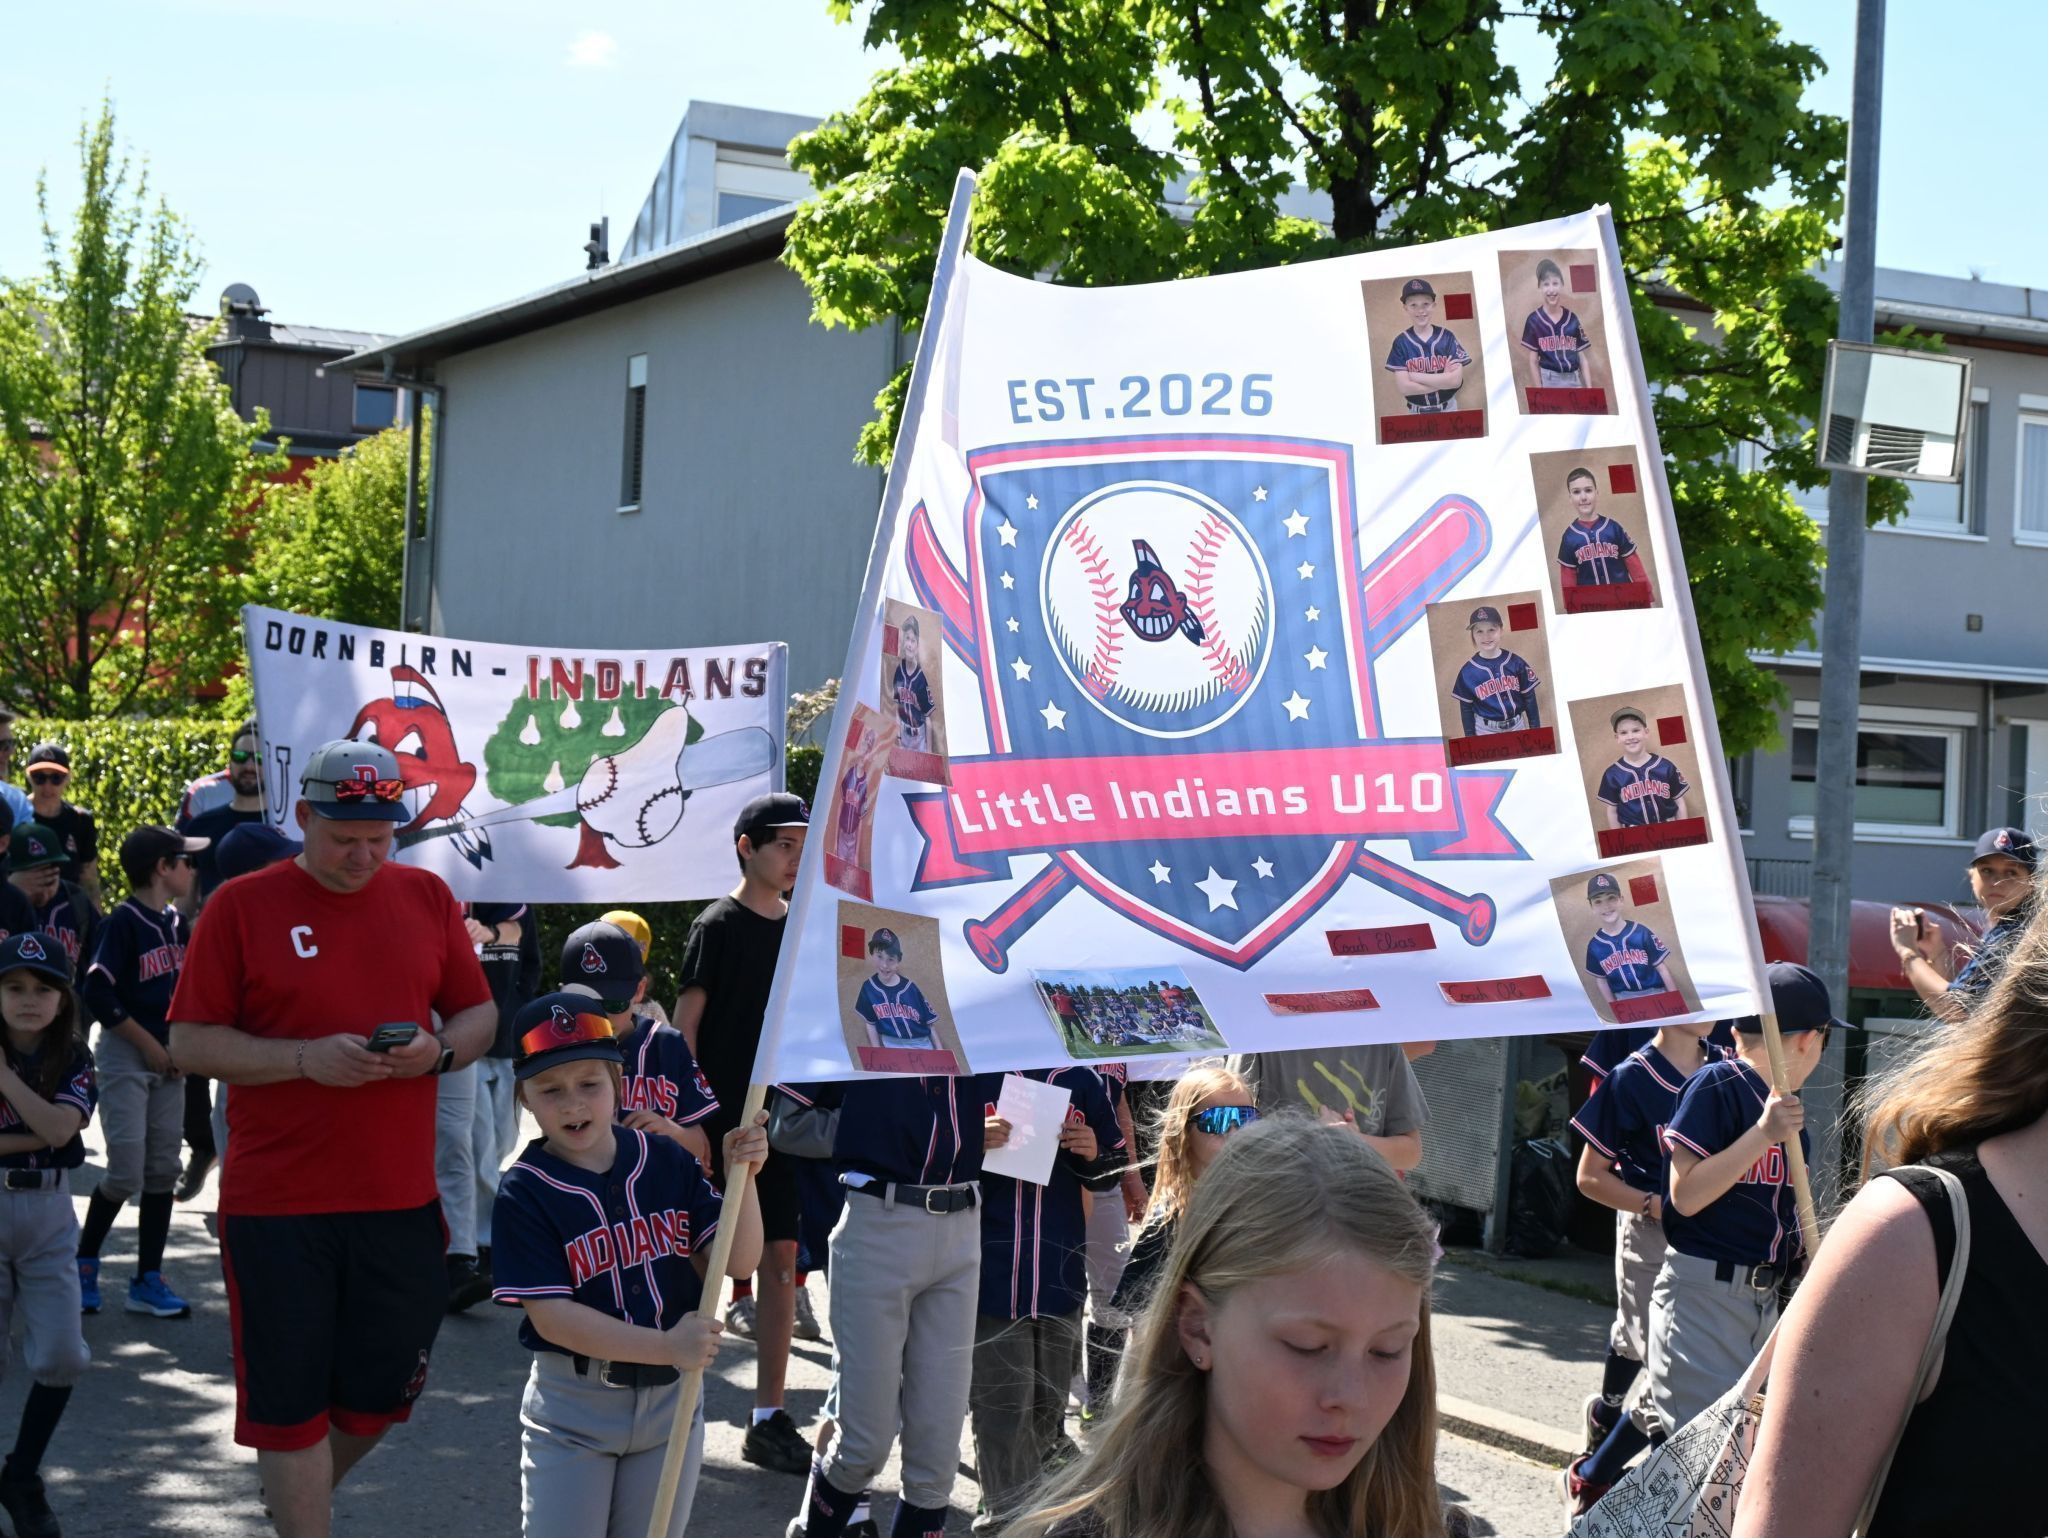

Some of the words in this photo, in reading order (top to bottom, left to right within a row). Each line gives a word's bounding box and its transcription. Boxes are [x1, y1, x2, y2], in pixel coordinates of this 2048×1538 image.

[265, 620, 473, 677] DORNBIRN
[526, 655, 768, 701] INDIANS
[951, 783, 1096, 834] Little
[1109, 776, 1306, 821] Indians
[1331, 772, 1443, 813] U10
[290, 925, 318, 959] C
[620, 1074, 679, 1120] IANS
[565, 1208, 690, 1288] NDIANS
